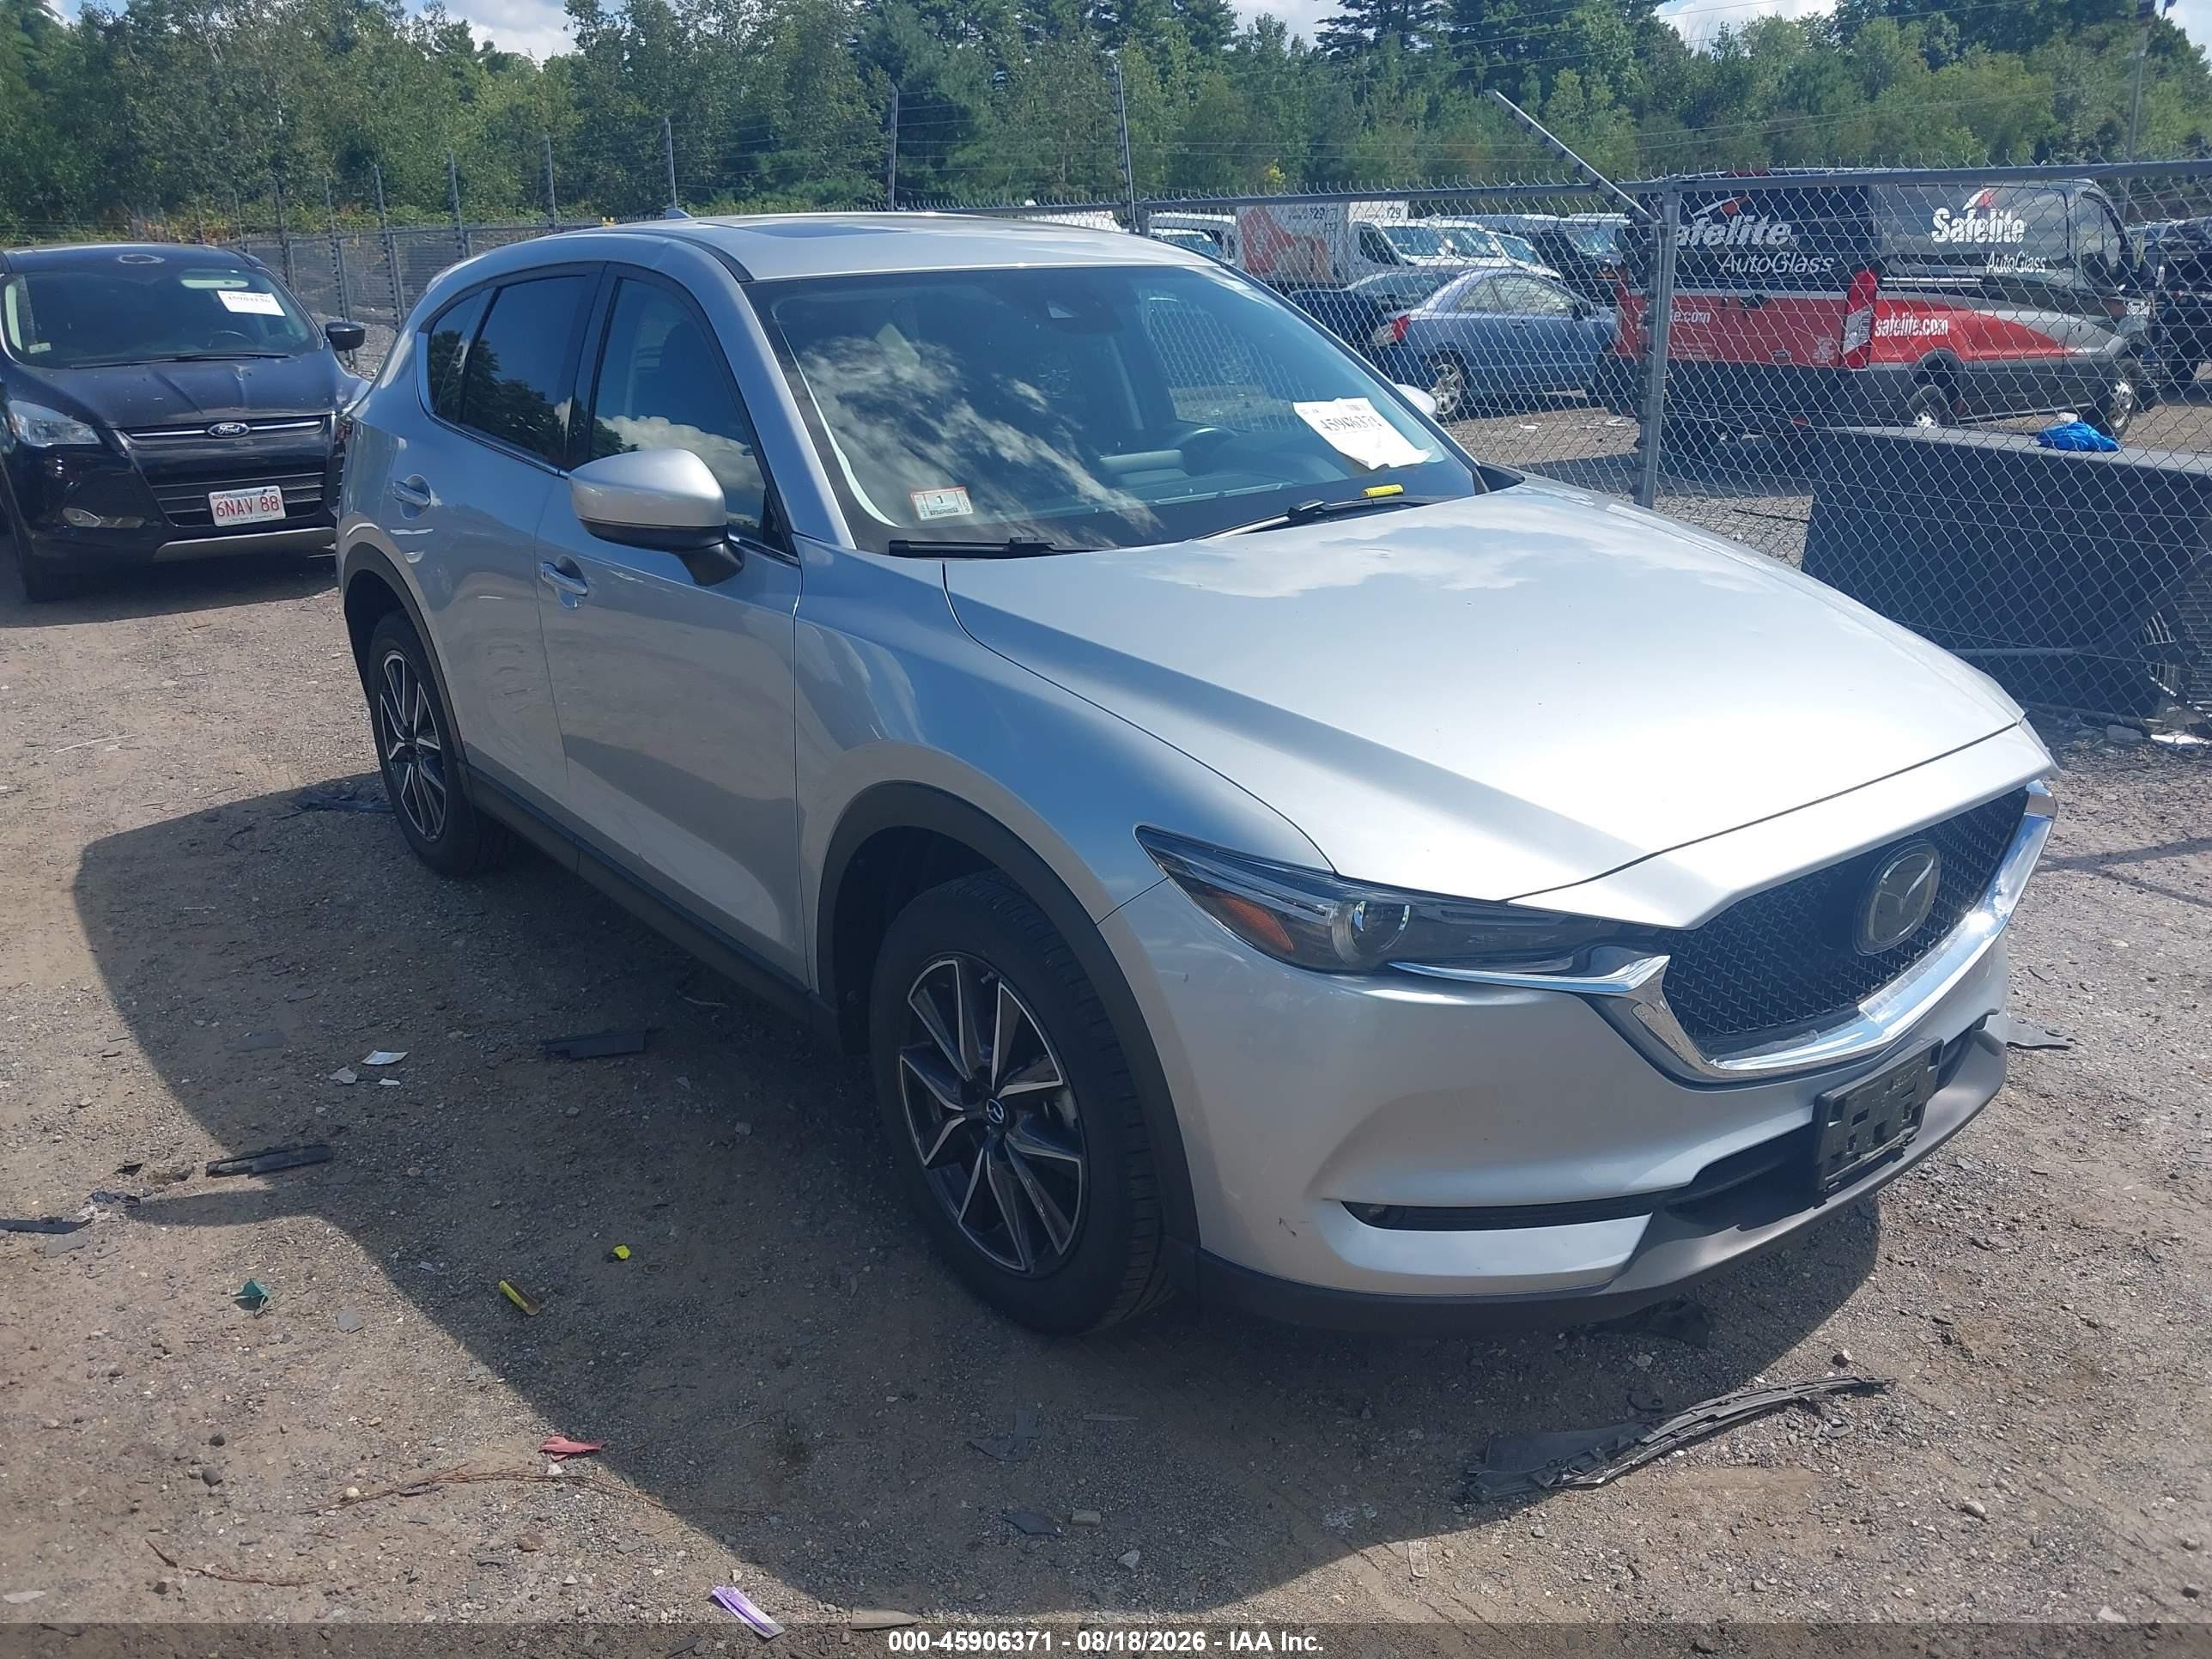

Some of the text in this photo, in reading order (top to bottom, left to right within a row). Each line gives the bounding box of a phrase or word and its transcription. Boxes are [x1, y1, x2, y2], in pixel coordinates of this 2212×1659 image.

[1677, 213, 1792, 246] afelite
[1930, 207, 2026, 244] Safelite
[1719, 252, 1835, 273] AutoGlass
[1985, 251, 2047, 274] AutoGlass
[1875, 312, 1949, 337] safelite.com
[217, 424, 240, 434] Ford
[216, 497, 254, 517] 6NAV
[260, 495, 280, 512] 88
[936, 495, 944, 504] 1
